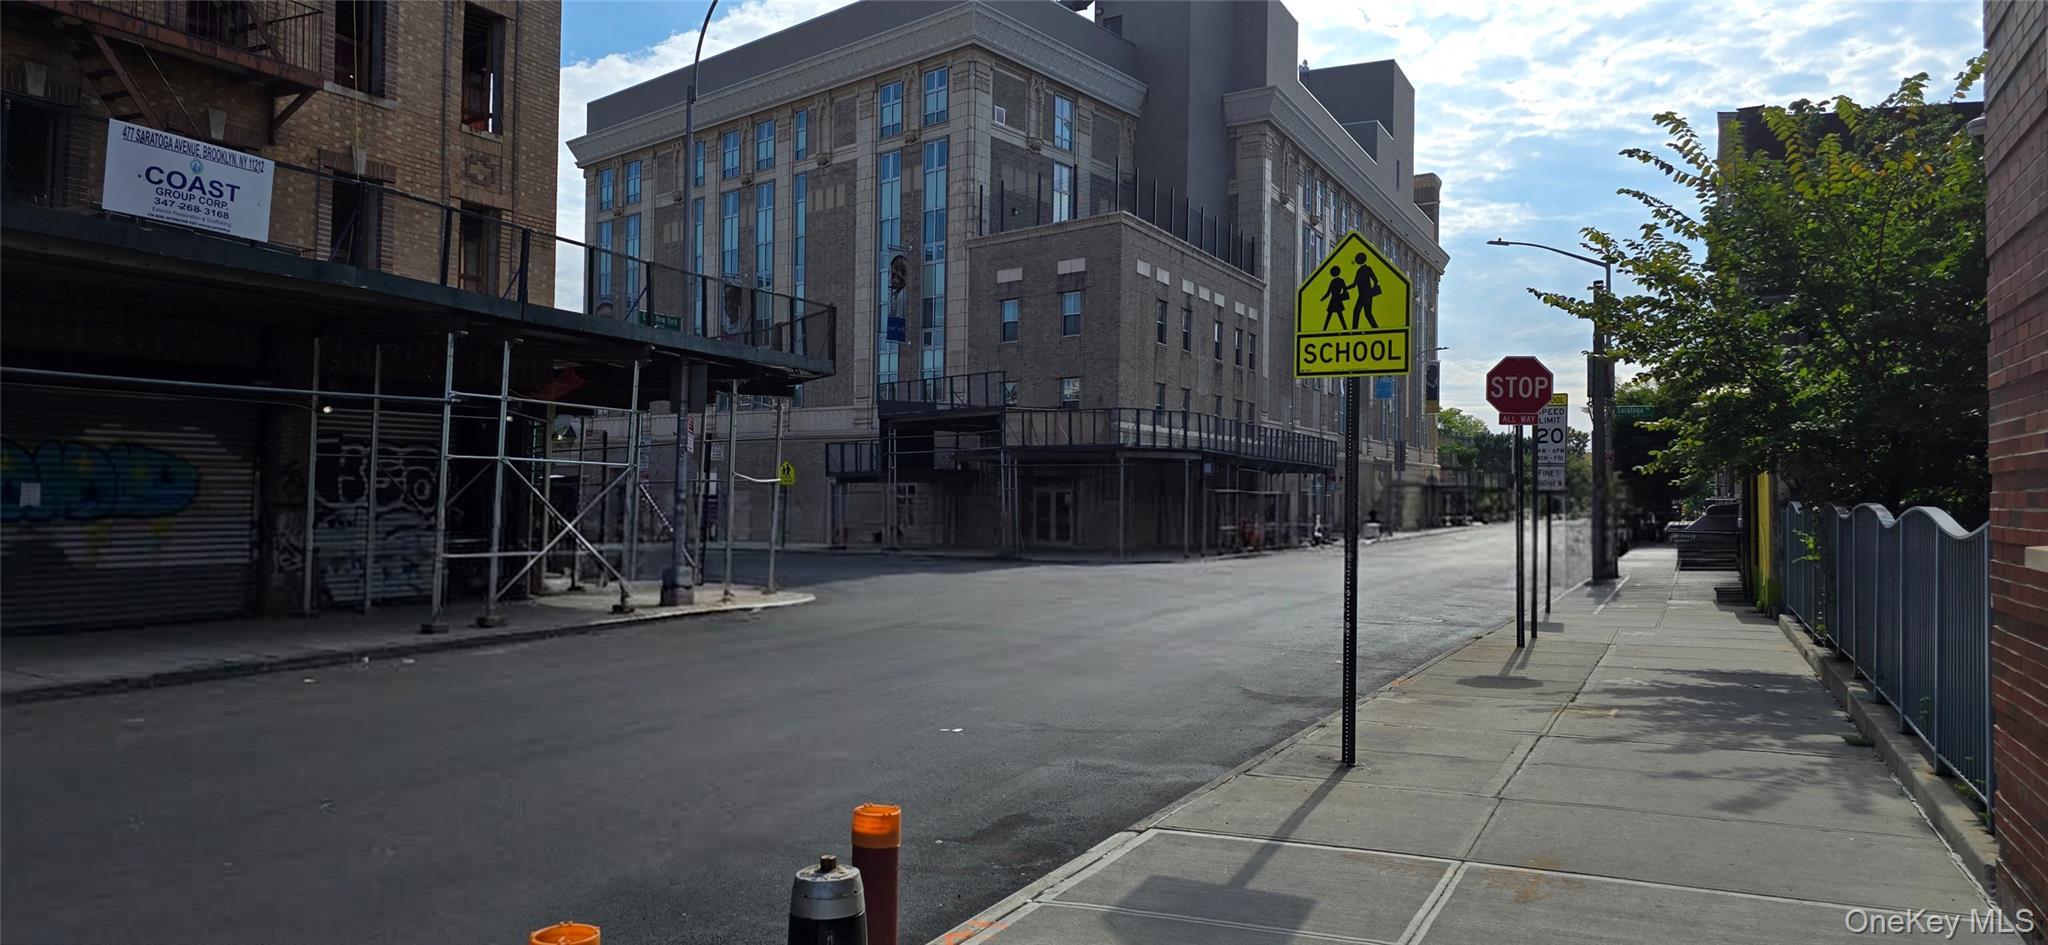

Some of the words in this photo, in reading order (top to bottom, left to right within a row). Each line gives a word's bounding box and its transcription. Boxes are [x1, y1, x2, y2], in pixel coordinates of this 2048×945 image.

[122, 126, 135, 140] 477
[135, 129, 173, 150] SARATOGA
[239, 156, 249, 168] NY
[248, 158, 265, 173] 11212
[145, 165, 241, 202] COAST
[155, 187, 196, 201] GROUP
[199, 196, 229, 210] CORP.
[1303, 339, 1401, 364] SCHOOL
[1490, 376, 1549, 399] STOP
[1502, 415, 1517, 423] ALL
[1520, 415, 1536, 423] WAY
[1539, 416, 1561, 425] LIMIT
[1540, 408, 1565, 416] PEED
[1538, 427, 1564, 444] 20
